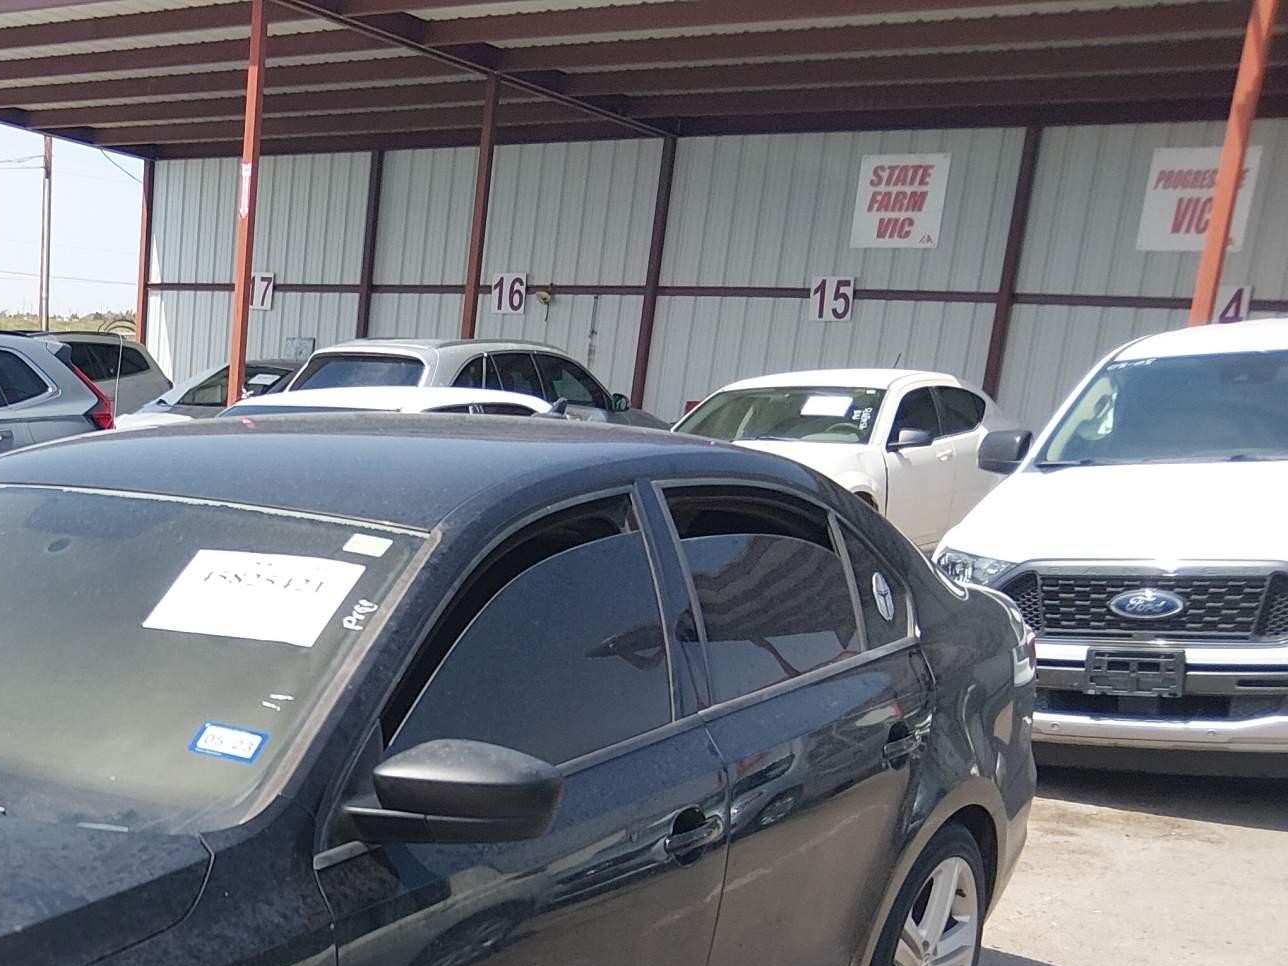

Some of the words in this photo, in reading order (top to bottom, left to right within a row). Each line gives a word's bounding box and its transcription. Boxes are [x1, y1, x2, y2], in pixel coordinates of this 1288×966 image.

[869, 164, 935, 187] STATE
[1153, 168, 1250, 190] PROGRESE
[867, 191, 928, 213] FARM
[1171, 195, 1214, 235] VIC
[876, 217, 914, 239] VIC
[493, 276, 524, 311] 16
[813, 279, 851, 319] 15
[1125, 595, 1166, 612] Ford
